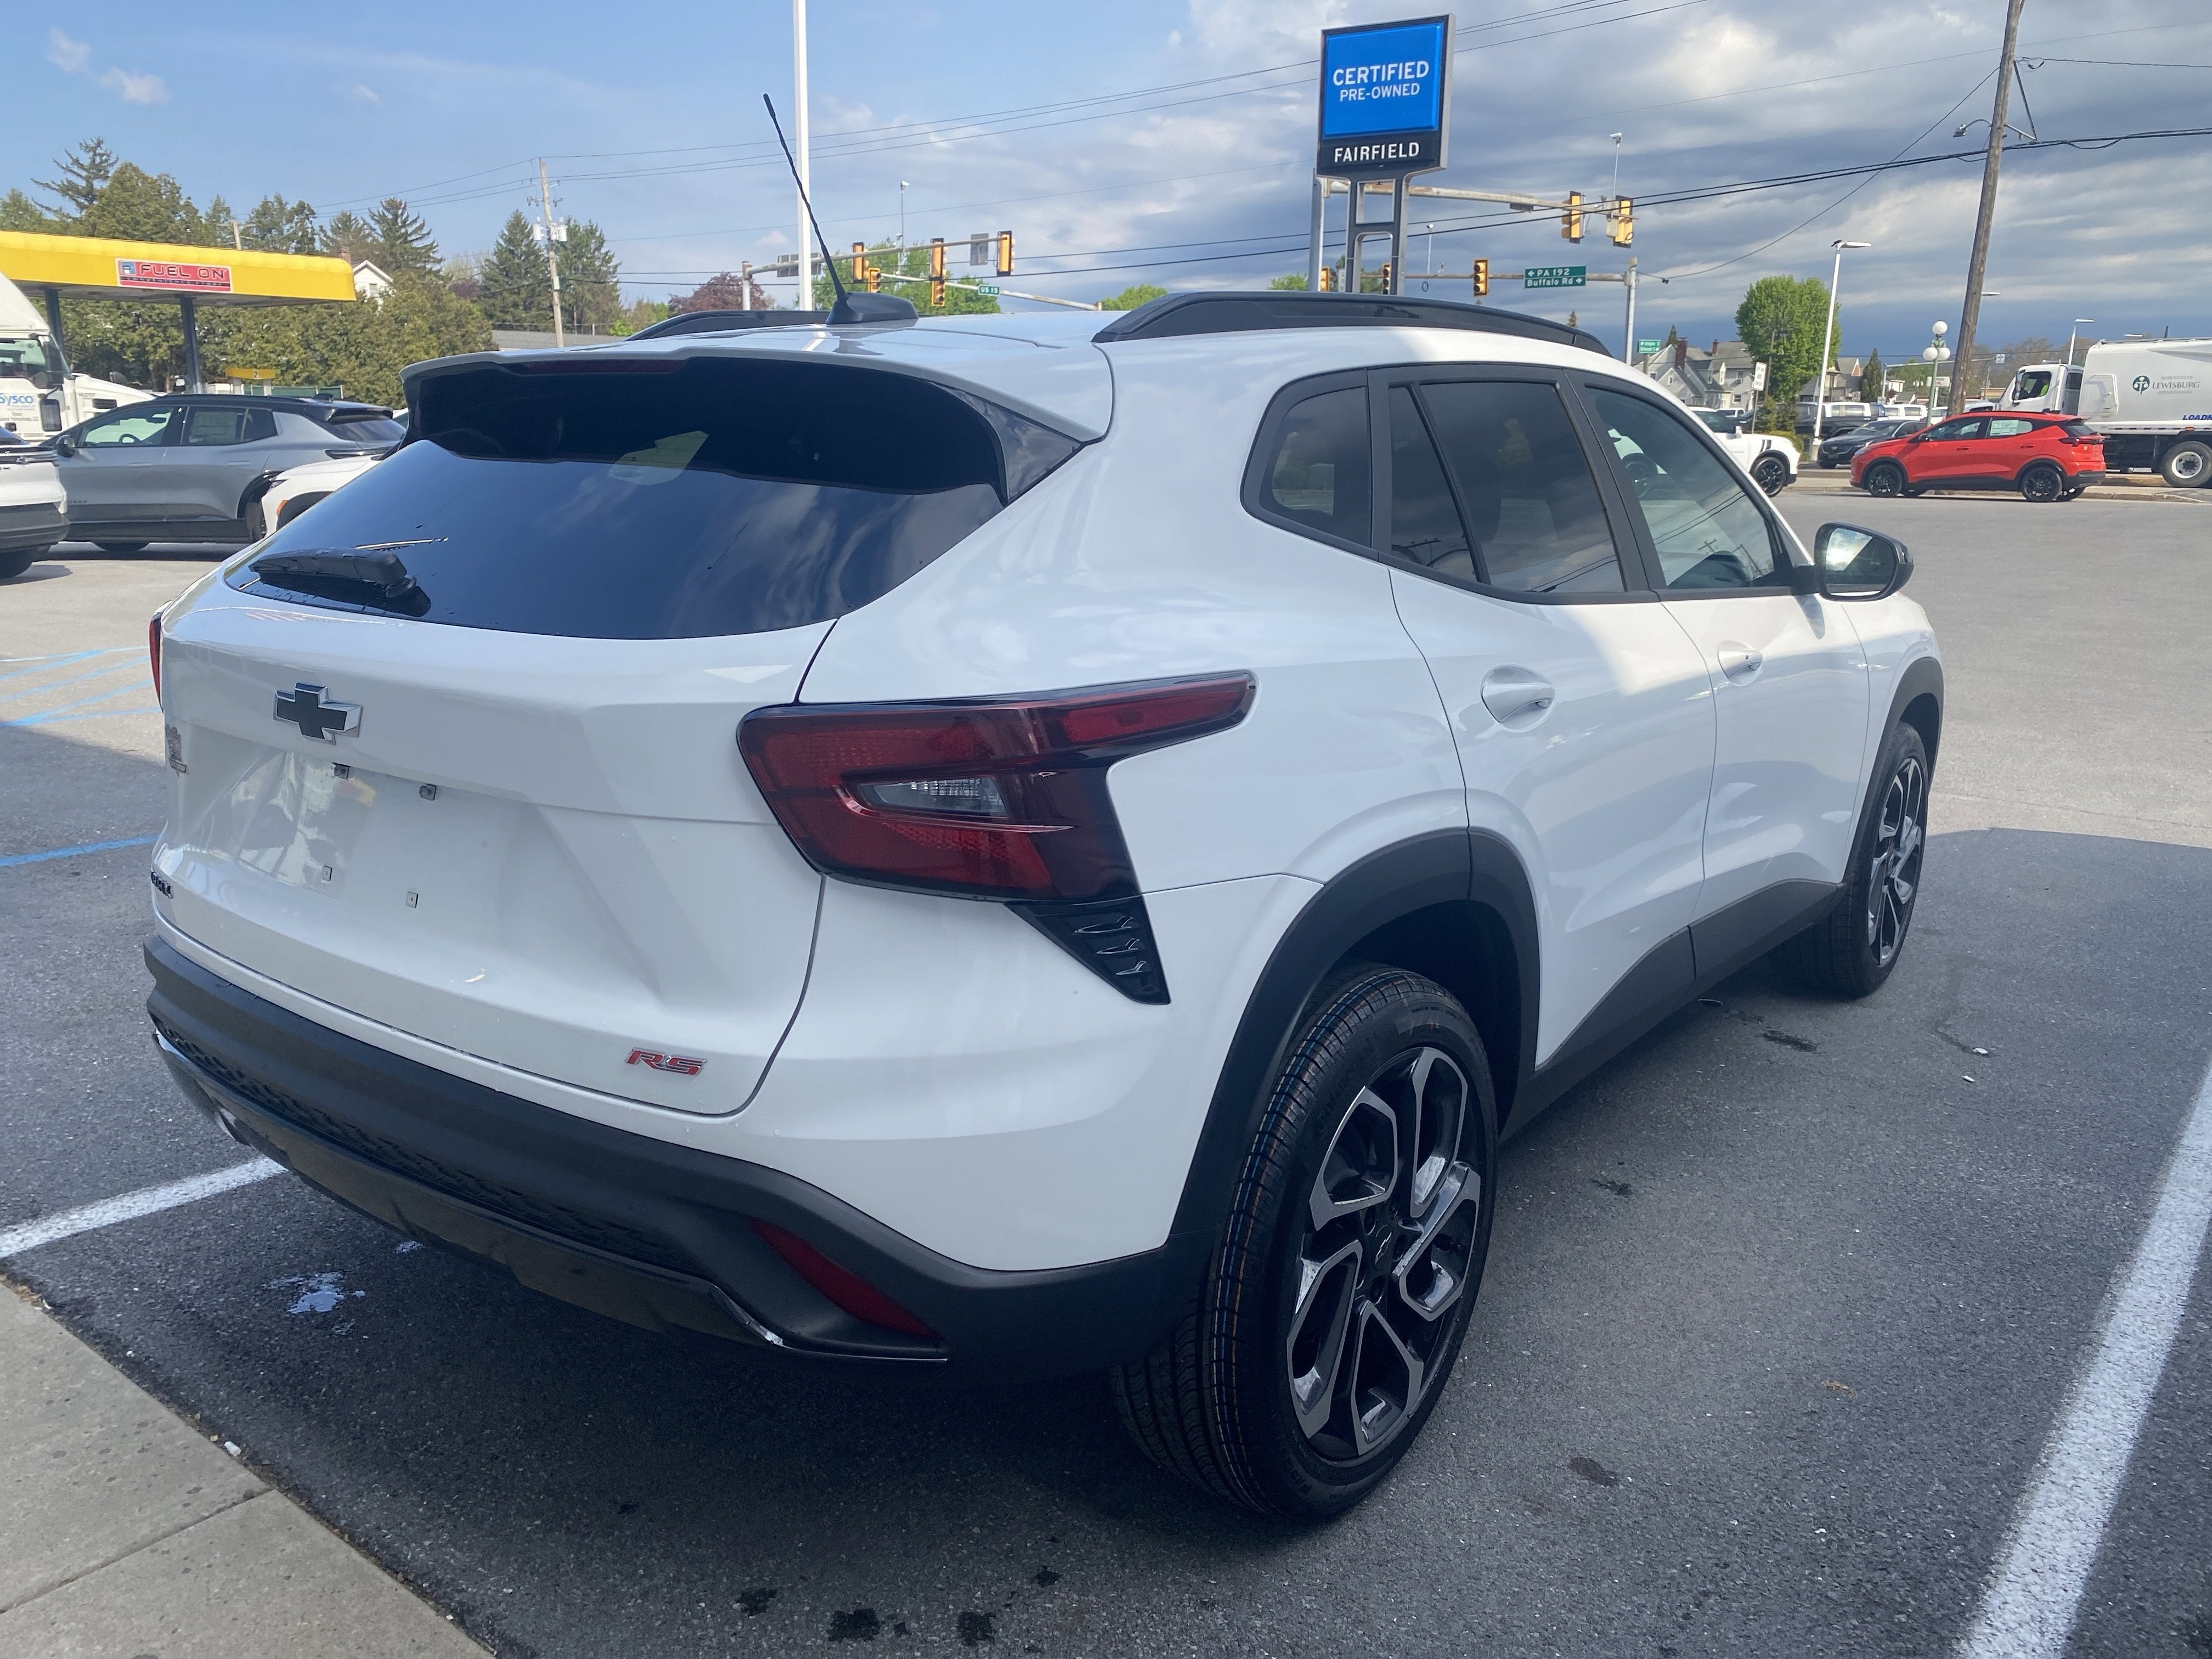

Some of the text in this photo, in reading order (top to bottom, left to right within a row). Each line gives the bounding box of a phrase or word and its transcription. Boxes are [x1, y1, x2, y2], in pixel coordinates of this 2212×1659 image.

[1333, 60, 1429, 86] CERTIFIED
[1340, 83, 1420, 101] PRE-OWNED
[1334, 142, 1420, 162] FAIRFIELD
[140, 264, 224, 279] FUEL ON
[625, 1047, 707, 1076] RS
